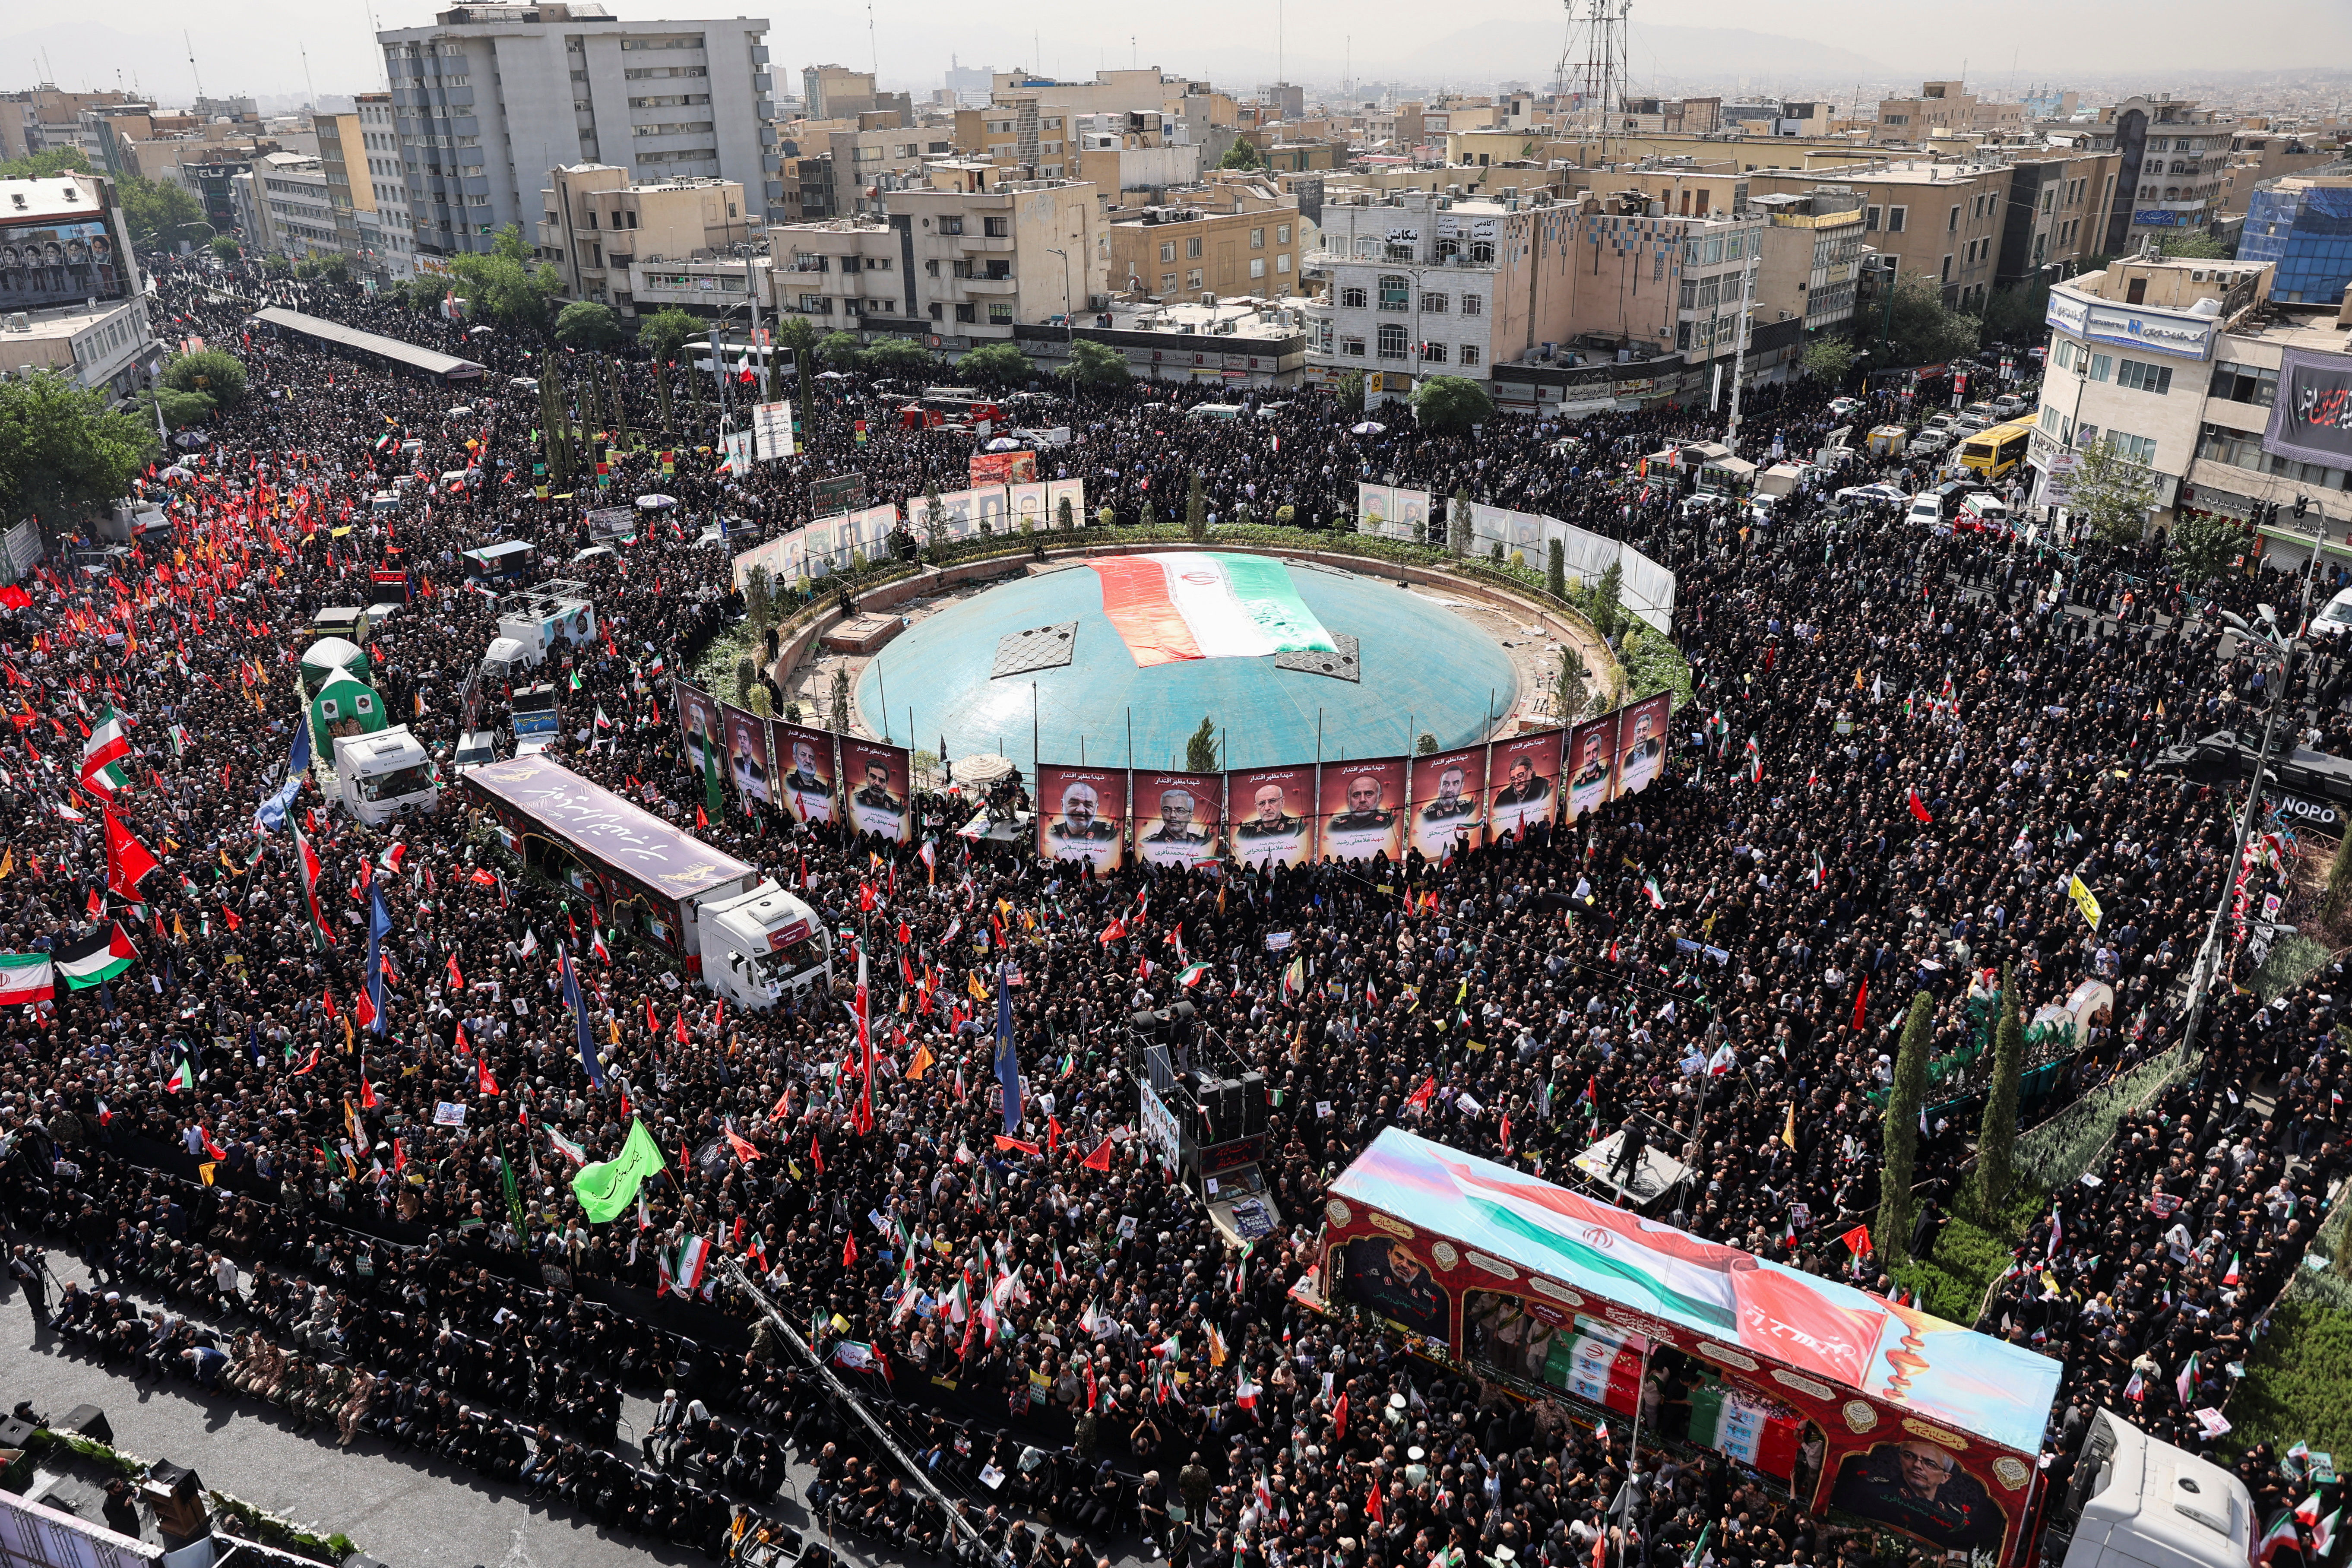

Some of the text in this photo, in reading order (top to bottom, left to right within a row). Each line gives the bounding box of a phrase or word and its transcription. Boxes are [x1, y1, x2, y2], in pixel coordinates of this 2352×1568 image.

[2136, 212, 2174, 222] دفتر اسناد رسمی
[1474, 219, 1495, 228] آکادمی
[1385, 229, 1418, 243] نیکایش
[2143, 327, 2208, 347] بانک صادرات ایران
[1570, 386, 1596, 396] ویتامینه
[1597, 383, 1610, 394] دکتر
[1634, 706, 1643, 715] اقتدار
[1583, 727, 1592, 736] اقتدار
[1592, 724, 1600, 732] مظهر
[1509, 744, 1522, 752] اقتدار
[1522, 741, 1534, 749] مظهر
[383, 757, 407, 767] BAHMAN
[1430, 760, 1444, 768] اقتدار
[1444, 757, 1457, 765] مظهر
[2282, 797, 2335, 823] NOPO
[1427, 830, 1440, 839] محقق
[1059, 844, 1077, 853] سلامی
[1375, 1216, 1393, 1229] شهادتیم
[1393, 1299, 1412, 1308] مهدی
